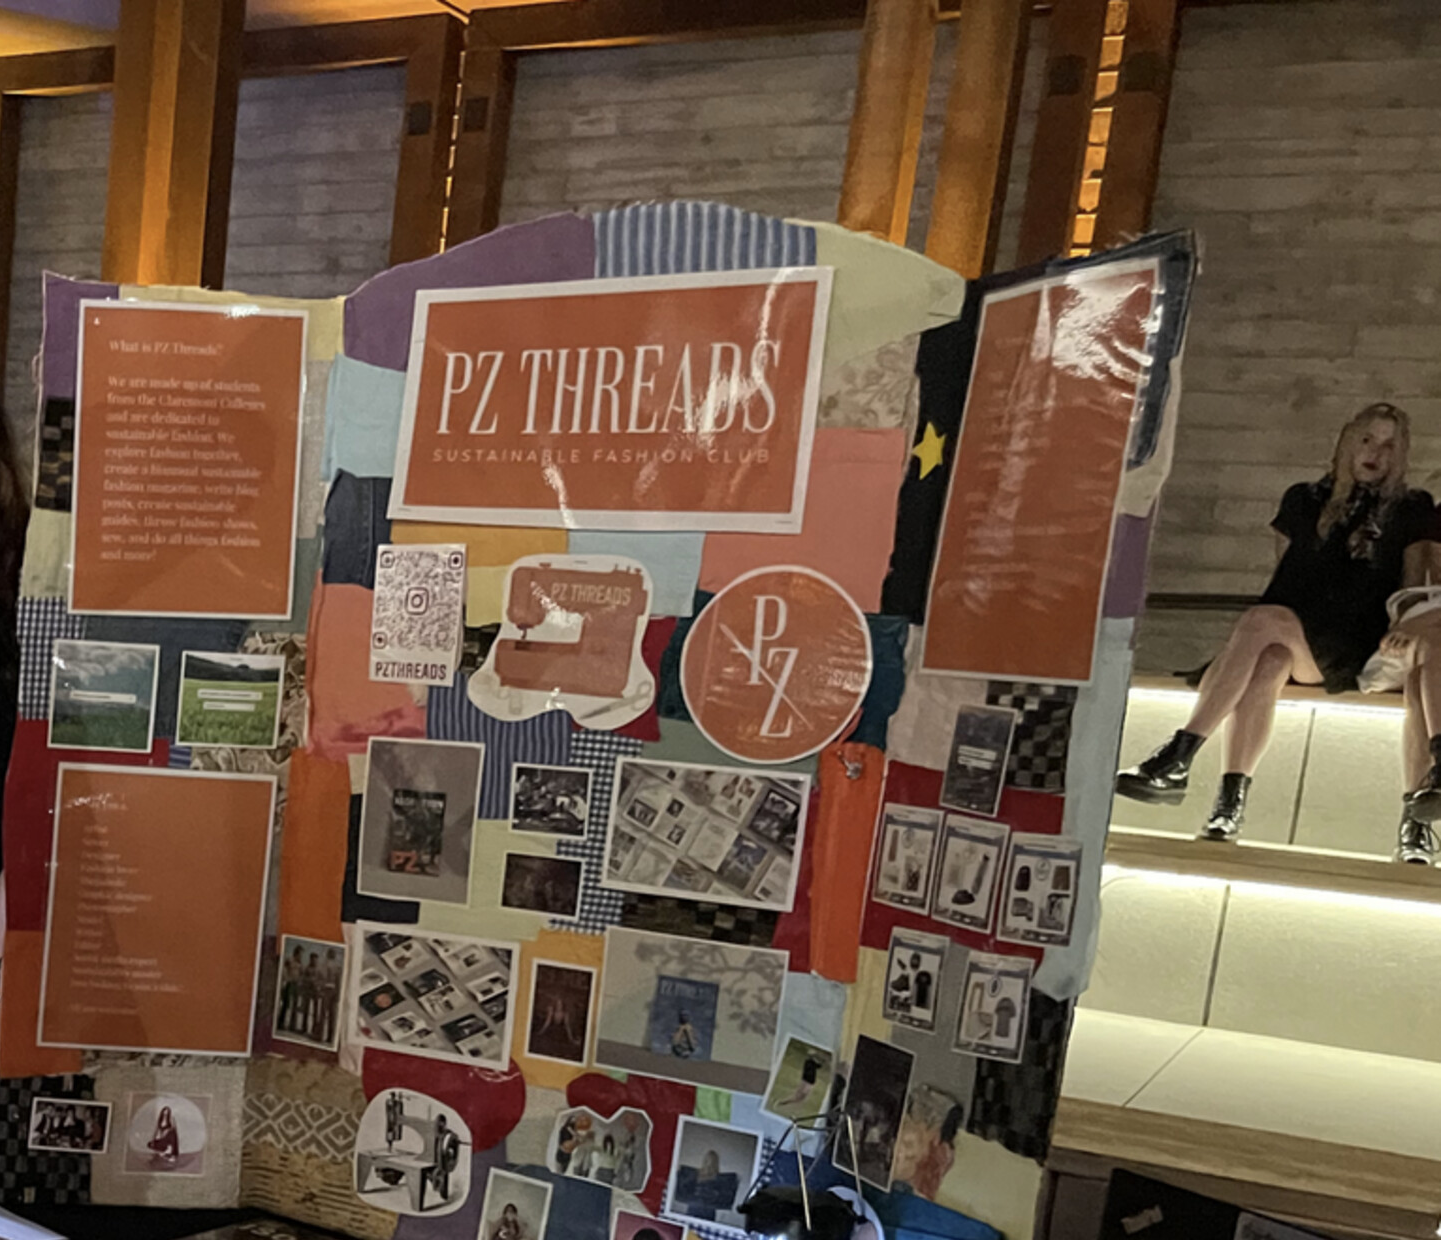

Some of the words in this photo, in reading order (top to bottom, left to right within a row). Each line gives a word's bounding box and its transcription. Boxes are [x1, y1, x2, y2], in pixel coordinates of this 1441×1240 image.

[436, 350, 505, 436] PZ
[519, 340, 782, 436] THREADS
[432, 447, 581, 464] SUSTAINABLE
[592, 448, 694, 464] FASHION
[707, 448, 771, 464] CLUB
[551, 582, 574, 602] PZ
[575, 584, 632, 607] THREADS
[374, 661, 448, 682] PZTHREADS
